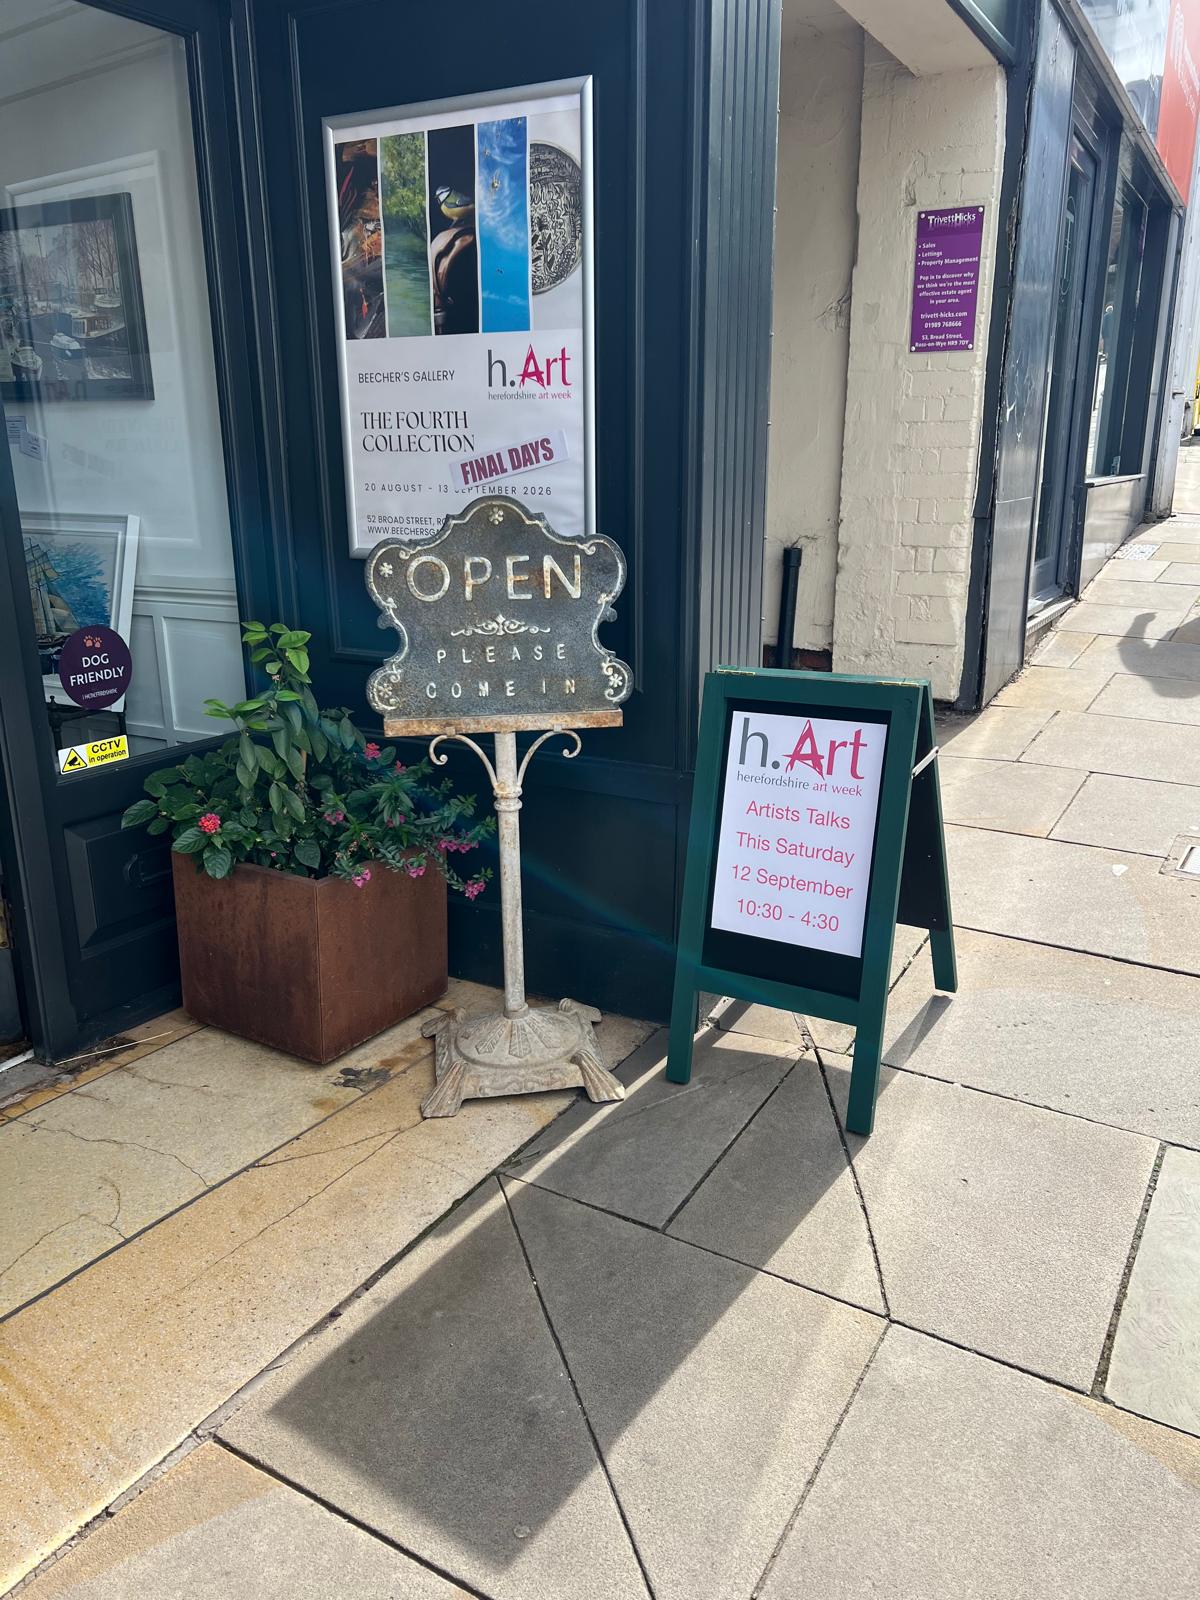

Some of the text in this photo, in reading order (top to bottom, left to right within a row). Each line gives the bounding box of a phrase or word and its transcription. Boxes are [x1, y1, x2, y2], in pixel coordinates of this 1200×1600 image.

[928, 212, 976, 224] TrivettHicks
[358, 370, 455, 384] BEECHER'S GALLERY
[488, 344, 572, 390] h.Art
[488, 391, 536, 400] herefordshire
[551, 390, 572, 400] week
[361, 410, 468, 430] THE FOURTH
[362, 434, 476, 453] COLLECTION
[460, 437, 554, 486] FINAL DAYS
[364, 482, 376, 492] 20
[382, 484, 422, 492] AUGUST
[439, 484, 448, 493] 13
[523, 486, 552, 496] 2026
[366, 514, 376, 523] 52
[378, 516, 404, 524] BROAD
[406, 516, 434, 526] STREET,
[406, 555, 582, 602] OPEN
[82, 653, 109, 668] DOG
[438, 644, 566, 664] PLEASE
[70, 666, 124, 687] FRIENDLY
[426, 680, 576, 698] COME IN
[88, 749, 126, 764] in operation
[92, 739, 121, 754] CCTV
[738, 718, 868, 780] h.Art
[737, 770, 862, 796] herefordshire art week
[746, 800, 850, 829] Artists Talks
[736, 832, 855, 868] This Saturday
[732, 864, 854, 900] 12 September
[737, 898, 782, 920] 10:30
[800, 911, 840, 932] 4:30
